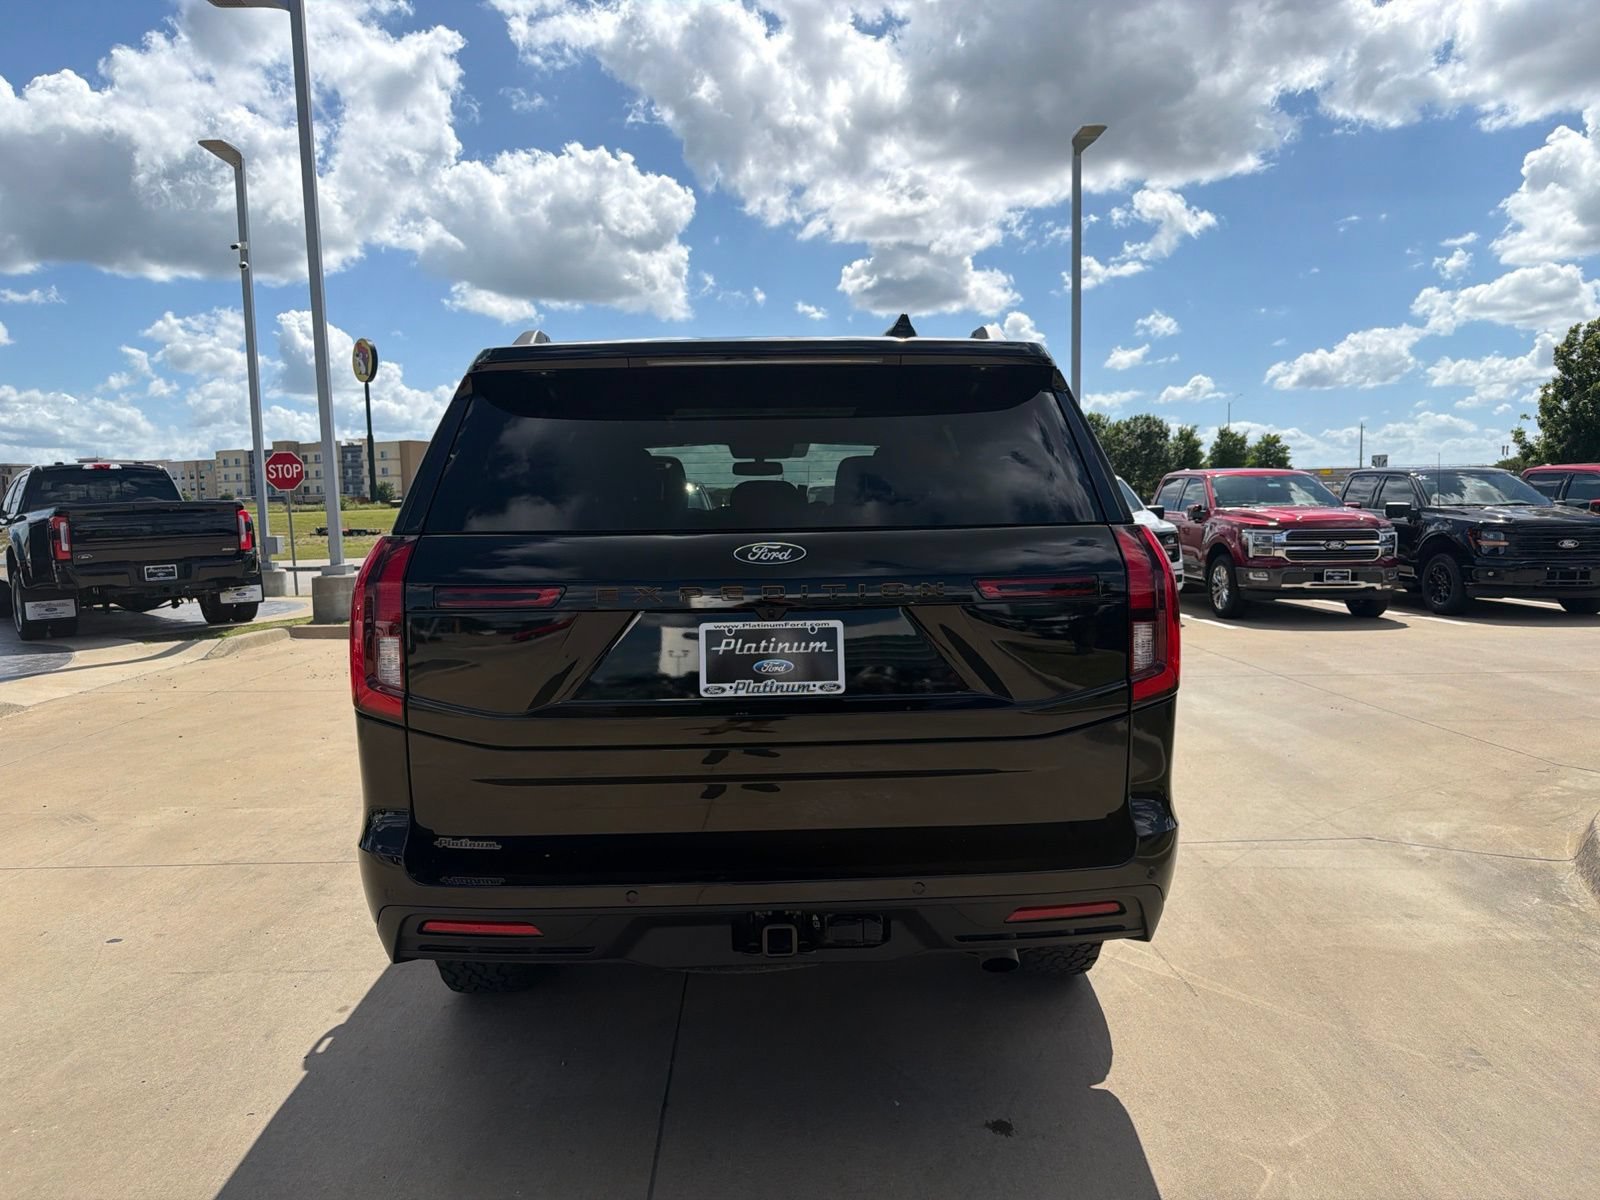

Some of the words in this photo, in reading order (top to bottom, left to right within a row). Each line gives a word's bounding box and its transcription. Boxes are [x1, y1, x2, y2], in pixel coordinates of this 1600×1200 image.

[268, 464, 302, 479] STOP
[747, 544, 792, 561] Ford
[594, 581, 945, 604] EXPEDITION
[713, 621, 830, 630] www.PlatinumFord.com
[711, 637, 834, 655] Platinum
[733, 679, 817, 695] Platinum
[433, 837, 503, 850] Platinum
